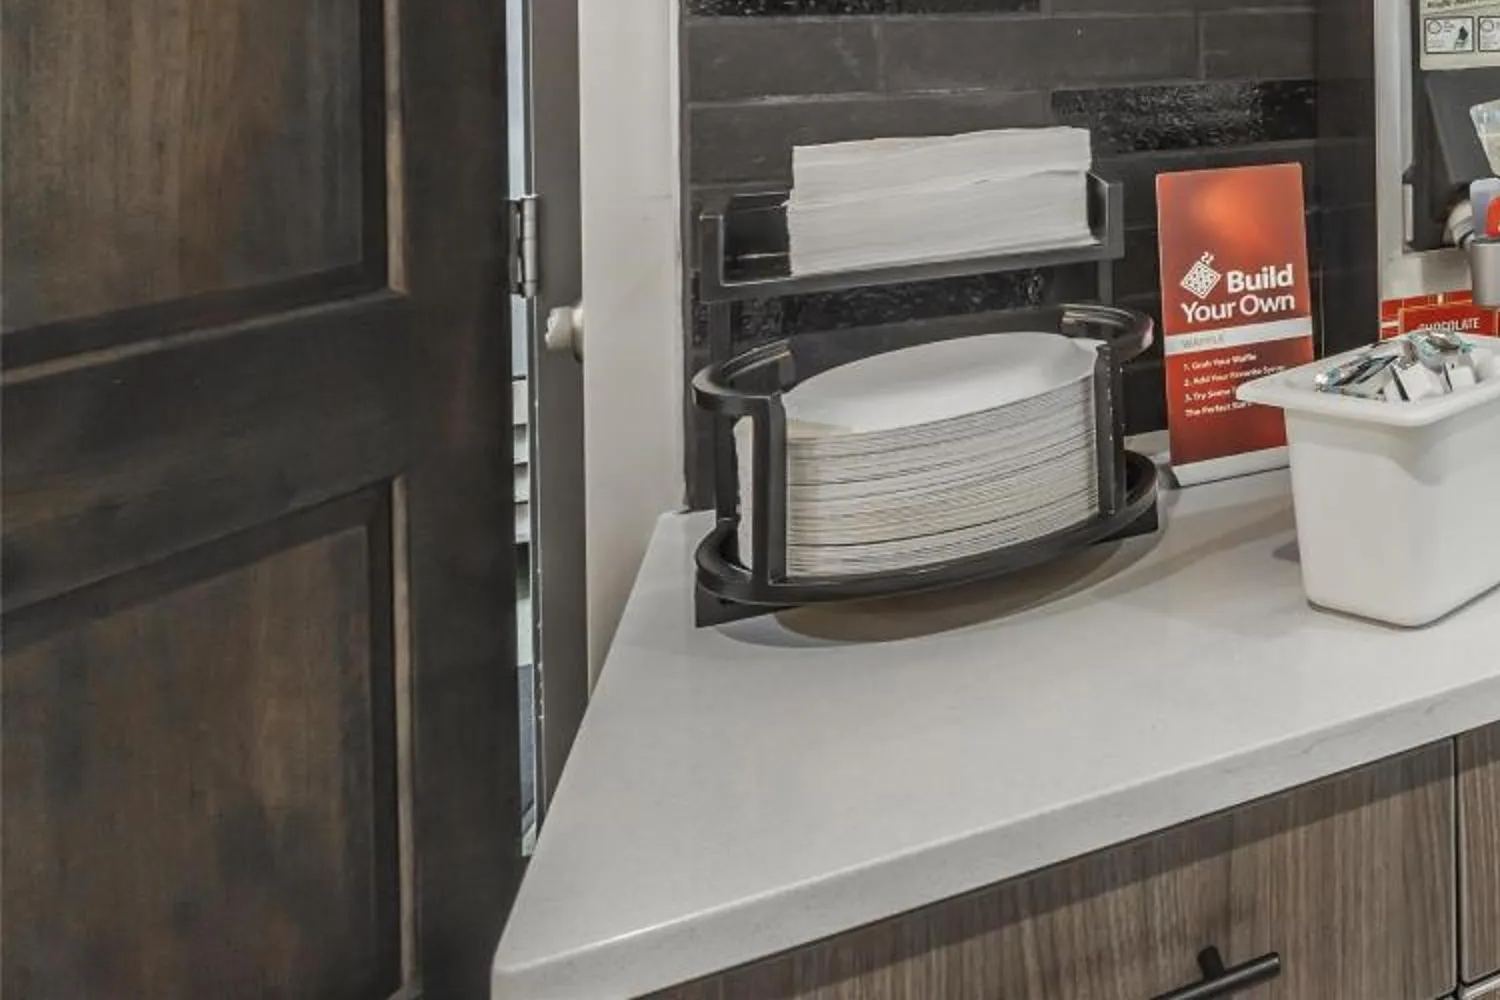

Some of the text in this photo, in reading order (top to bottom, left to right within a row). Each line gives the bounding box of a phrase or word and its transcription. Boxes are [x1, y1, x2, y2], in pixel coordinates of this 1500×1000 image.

[1226, 263, 1294, 294] Build
[1181, 294, 1295, 323] Your Own
